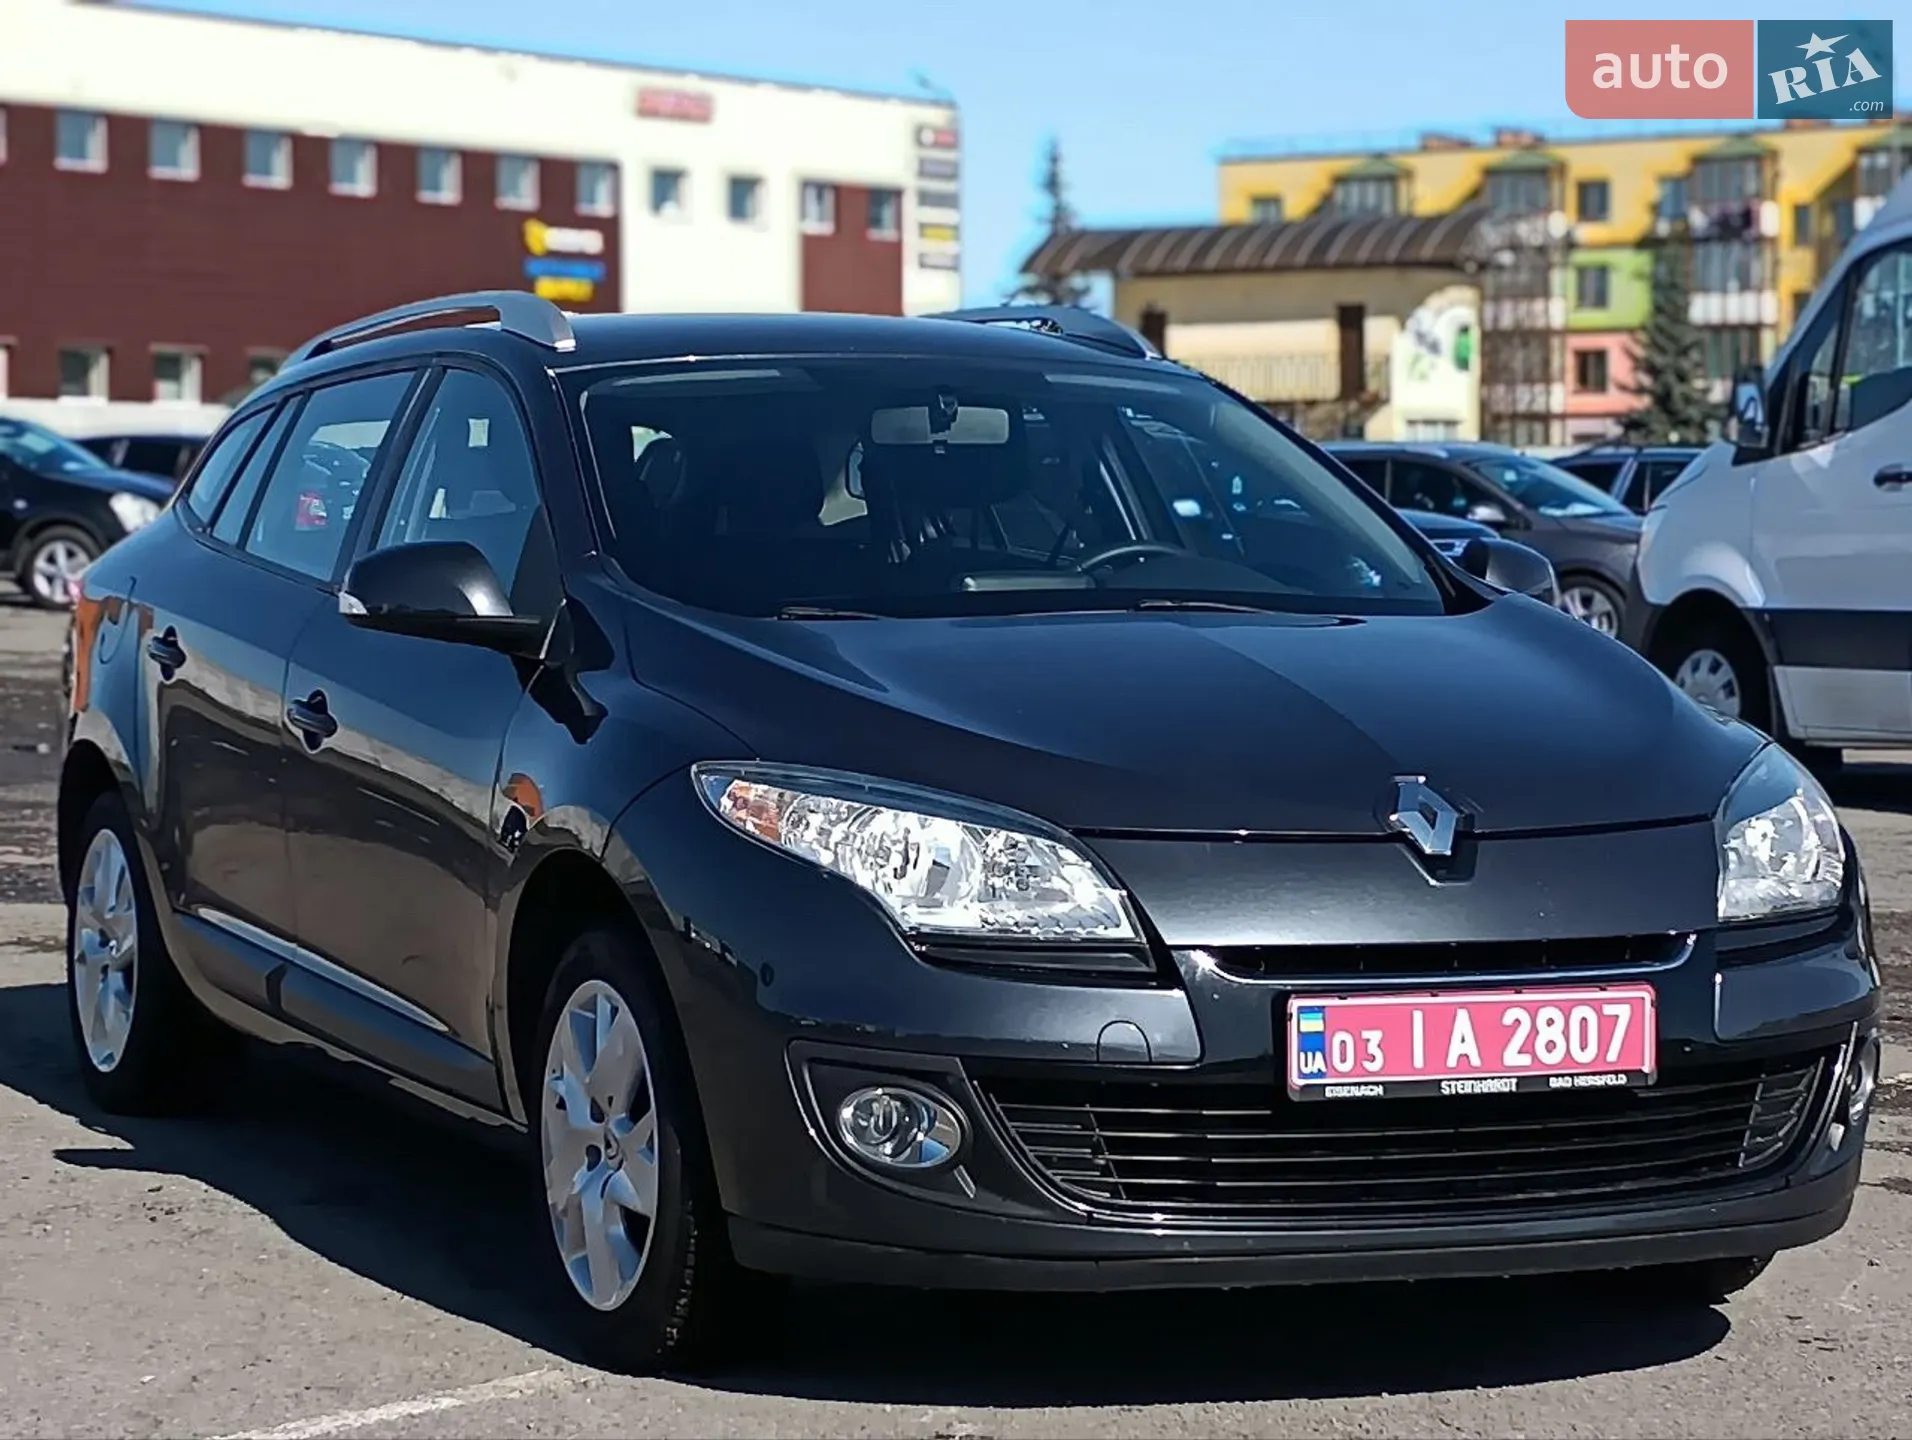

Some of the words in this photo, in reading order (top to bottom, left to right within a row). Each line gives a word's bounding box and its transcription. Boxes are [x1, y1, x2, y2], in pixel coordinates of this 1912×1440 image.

[1331, 1029, 1385, 1073] 03
[1501, 1003, 1632, 1067] 2807
[1299, 1051, 1327, 1074] UA
